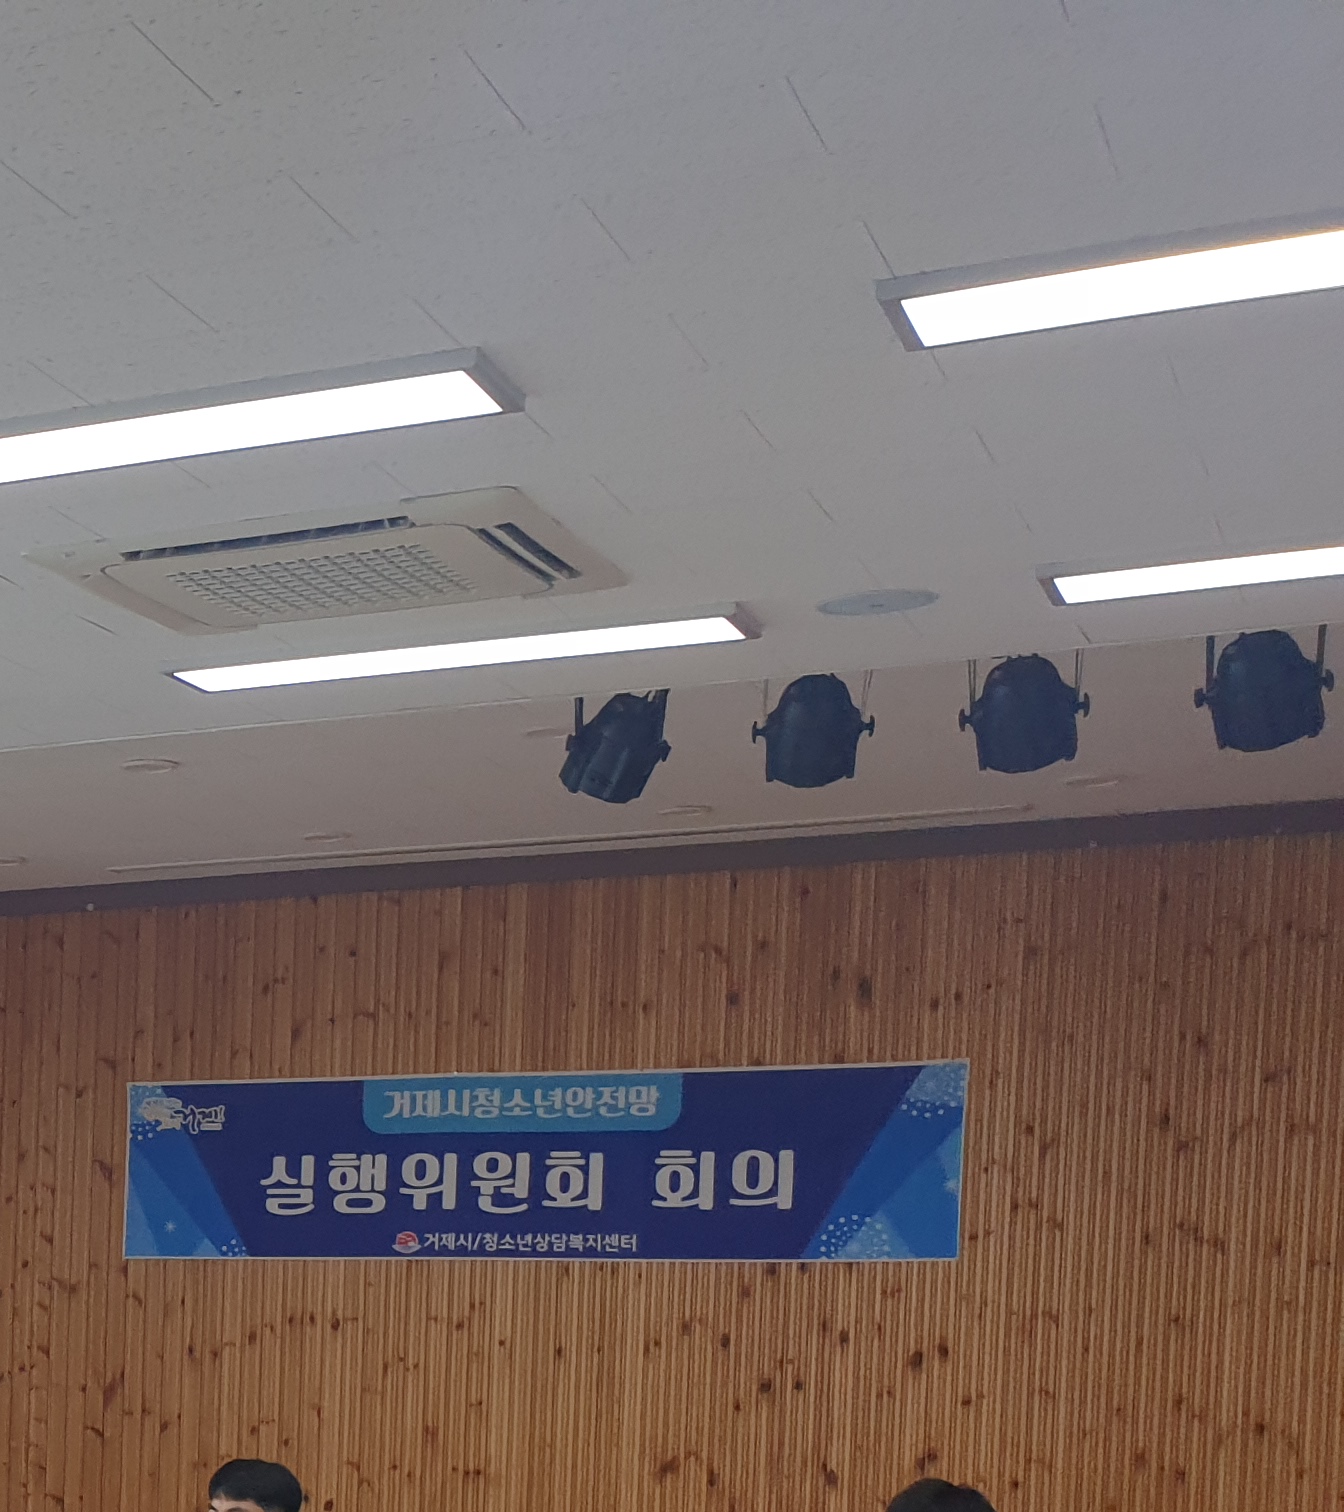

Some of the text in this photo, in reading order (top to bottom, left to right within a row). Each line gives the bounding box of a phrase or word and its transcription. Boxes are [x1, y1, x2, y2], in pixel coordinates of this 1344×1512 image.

[383, 1085, 660, 1118] 거제시청소년안전망
[260, 1149, 794, 1216] 실행위원회 회의
[423, 1232, 638, 1252] 거제시/청소년상담복지센터
